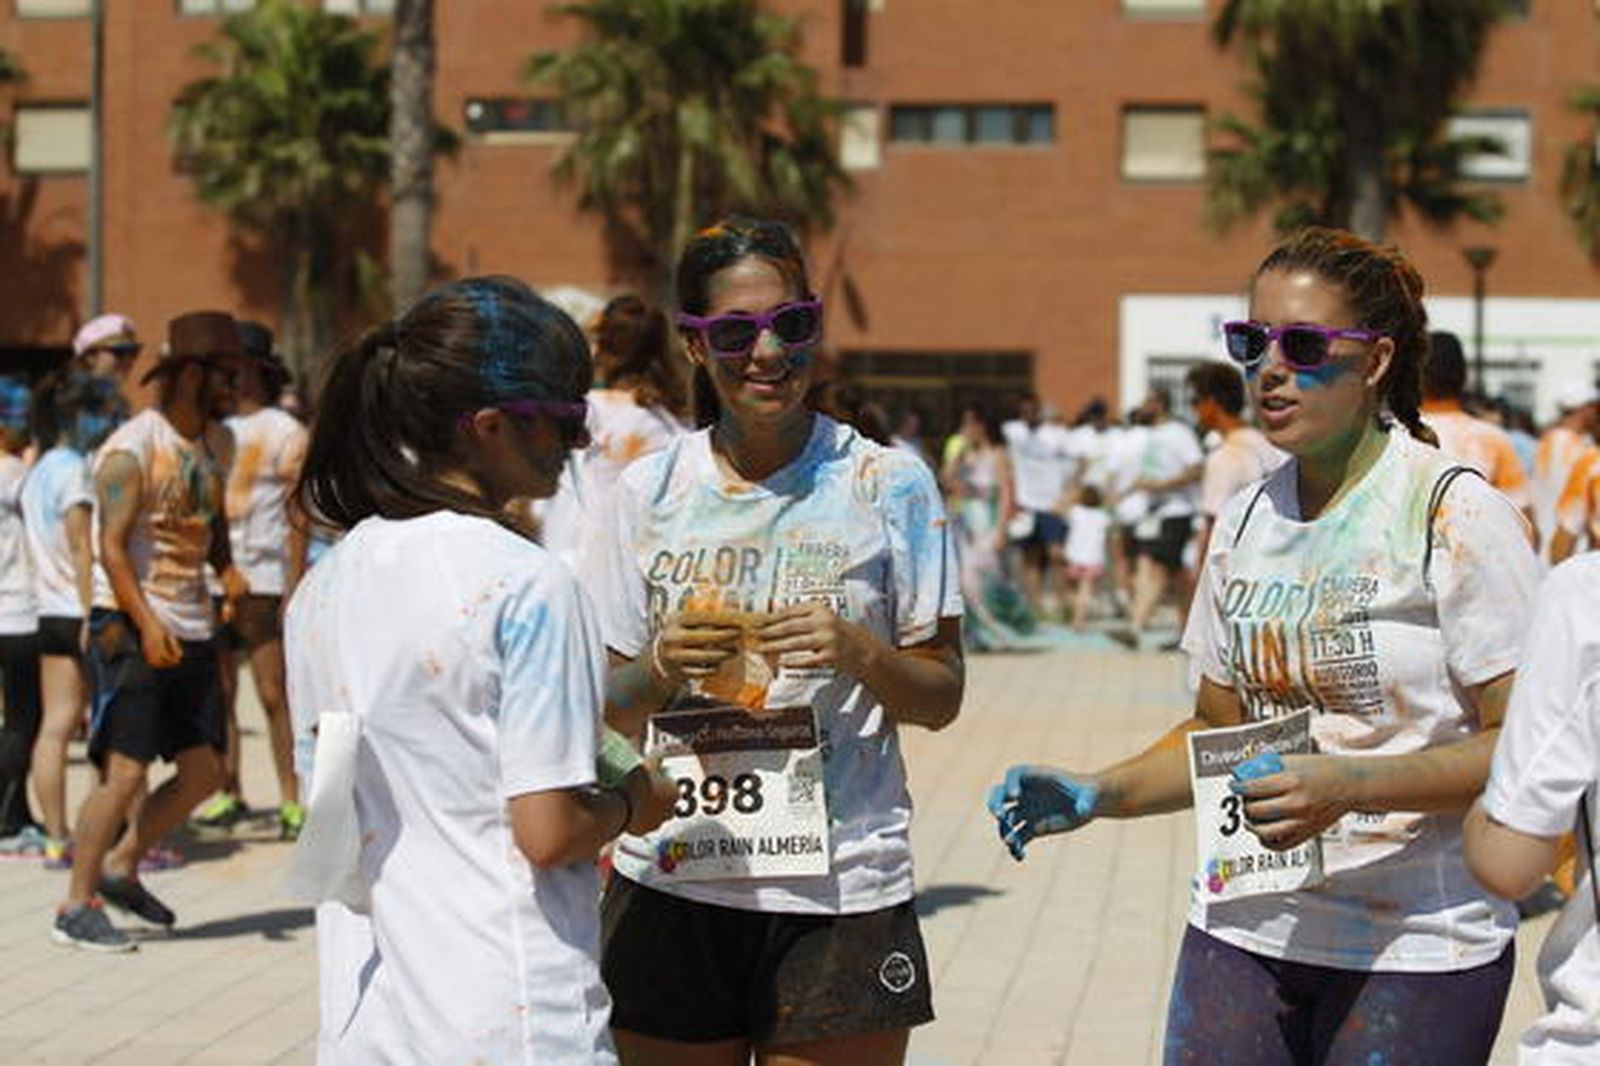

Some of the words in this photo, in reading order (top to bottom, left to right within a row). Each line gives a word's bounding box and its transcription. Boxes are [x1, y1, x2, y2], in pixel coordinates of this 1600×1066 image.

[649, 545, 762, 586] COLOR
[1225, 579, 1304, 618] OLOR
[673, 773, 764, 818] 398
[718, 836, 754, 857] RAIN
[1257, 852, 1287, 872] RAIN
